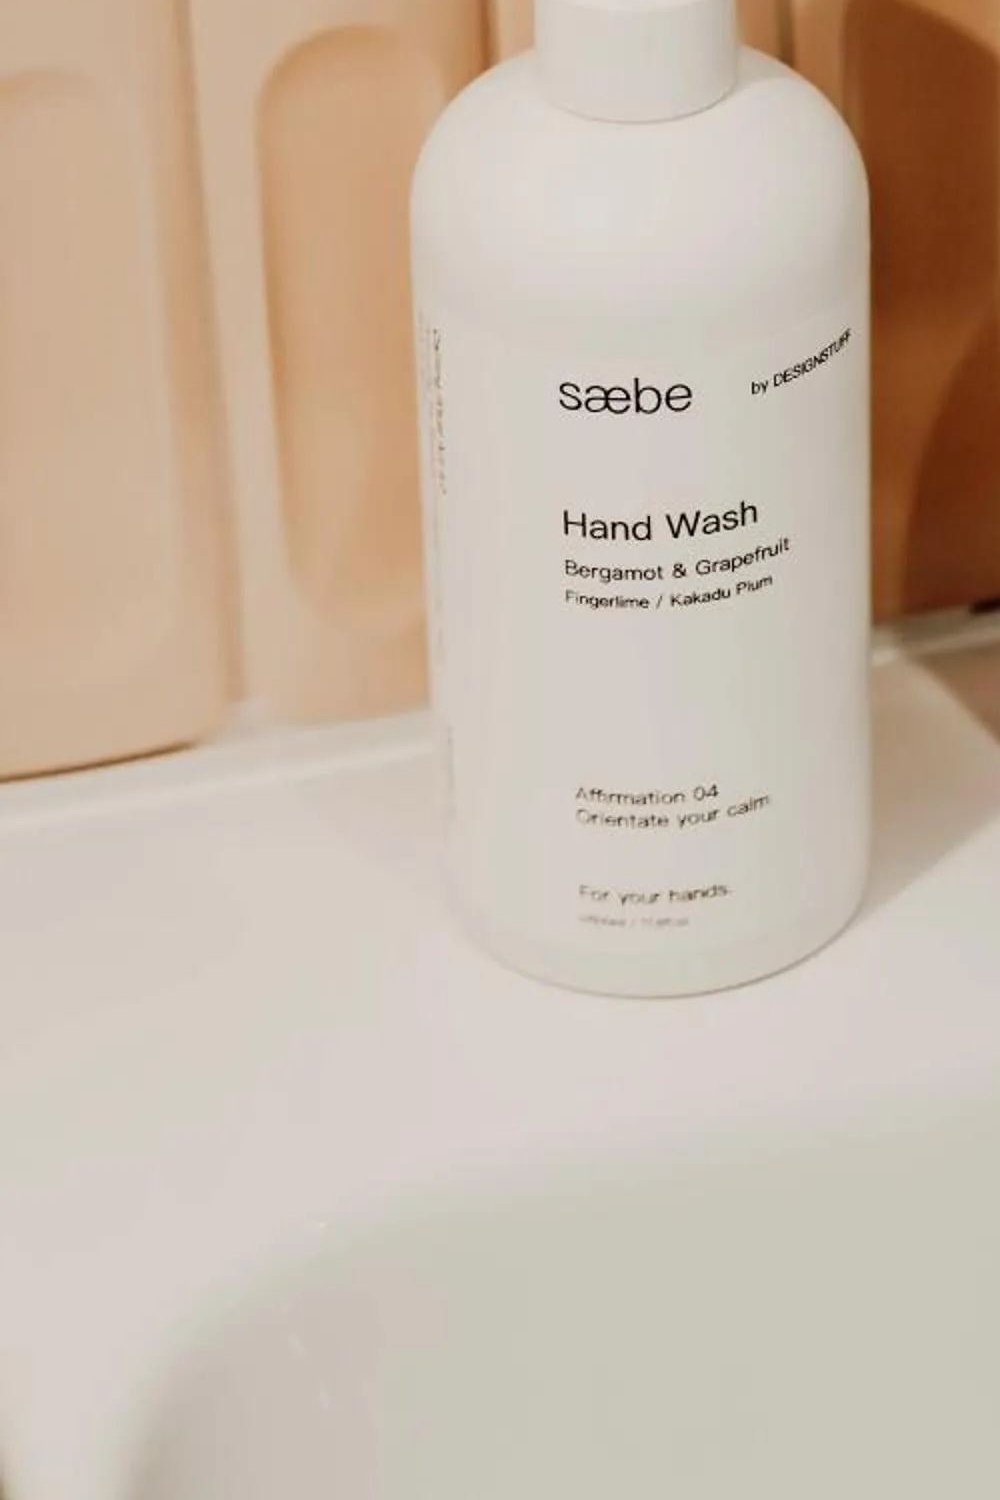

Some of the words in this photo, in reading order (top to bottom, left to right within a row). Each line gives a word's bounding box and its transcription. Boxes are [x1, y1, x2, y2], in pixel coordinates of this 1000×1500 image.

[751, 378, 769, 395] by
[773, 328, 851, 387] DESIGNSTUFF
[559, 377, 692, 414] sæbe
[563, 509, 651, 541] Hand
[665, 501, 757, 538] Wash
[565, 559, 663, 583] Bergamot
[672, 563, 687, 579] &
[695, 536, 790, 576] Grapefruit
[565, 589, 649, 609] Fingerlime
[655, 596, 663, 608] /
[670, 588, 731, 608] Kakadu
[736, 574, 773, 595] Plum
[575, 787, 685, 805] Affirmation
[693, 784, 719, 801] 04
[575, 809, 669, 828] Orientate
[677, 808, 720, 829] your
[726, 794, 770, 817] calm
[579, 885, 608, 900] For
[618, 892, 660, 906] your
